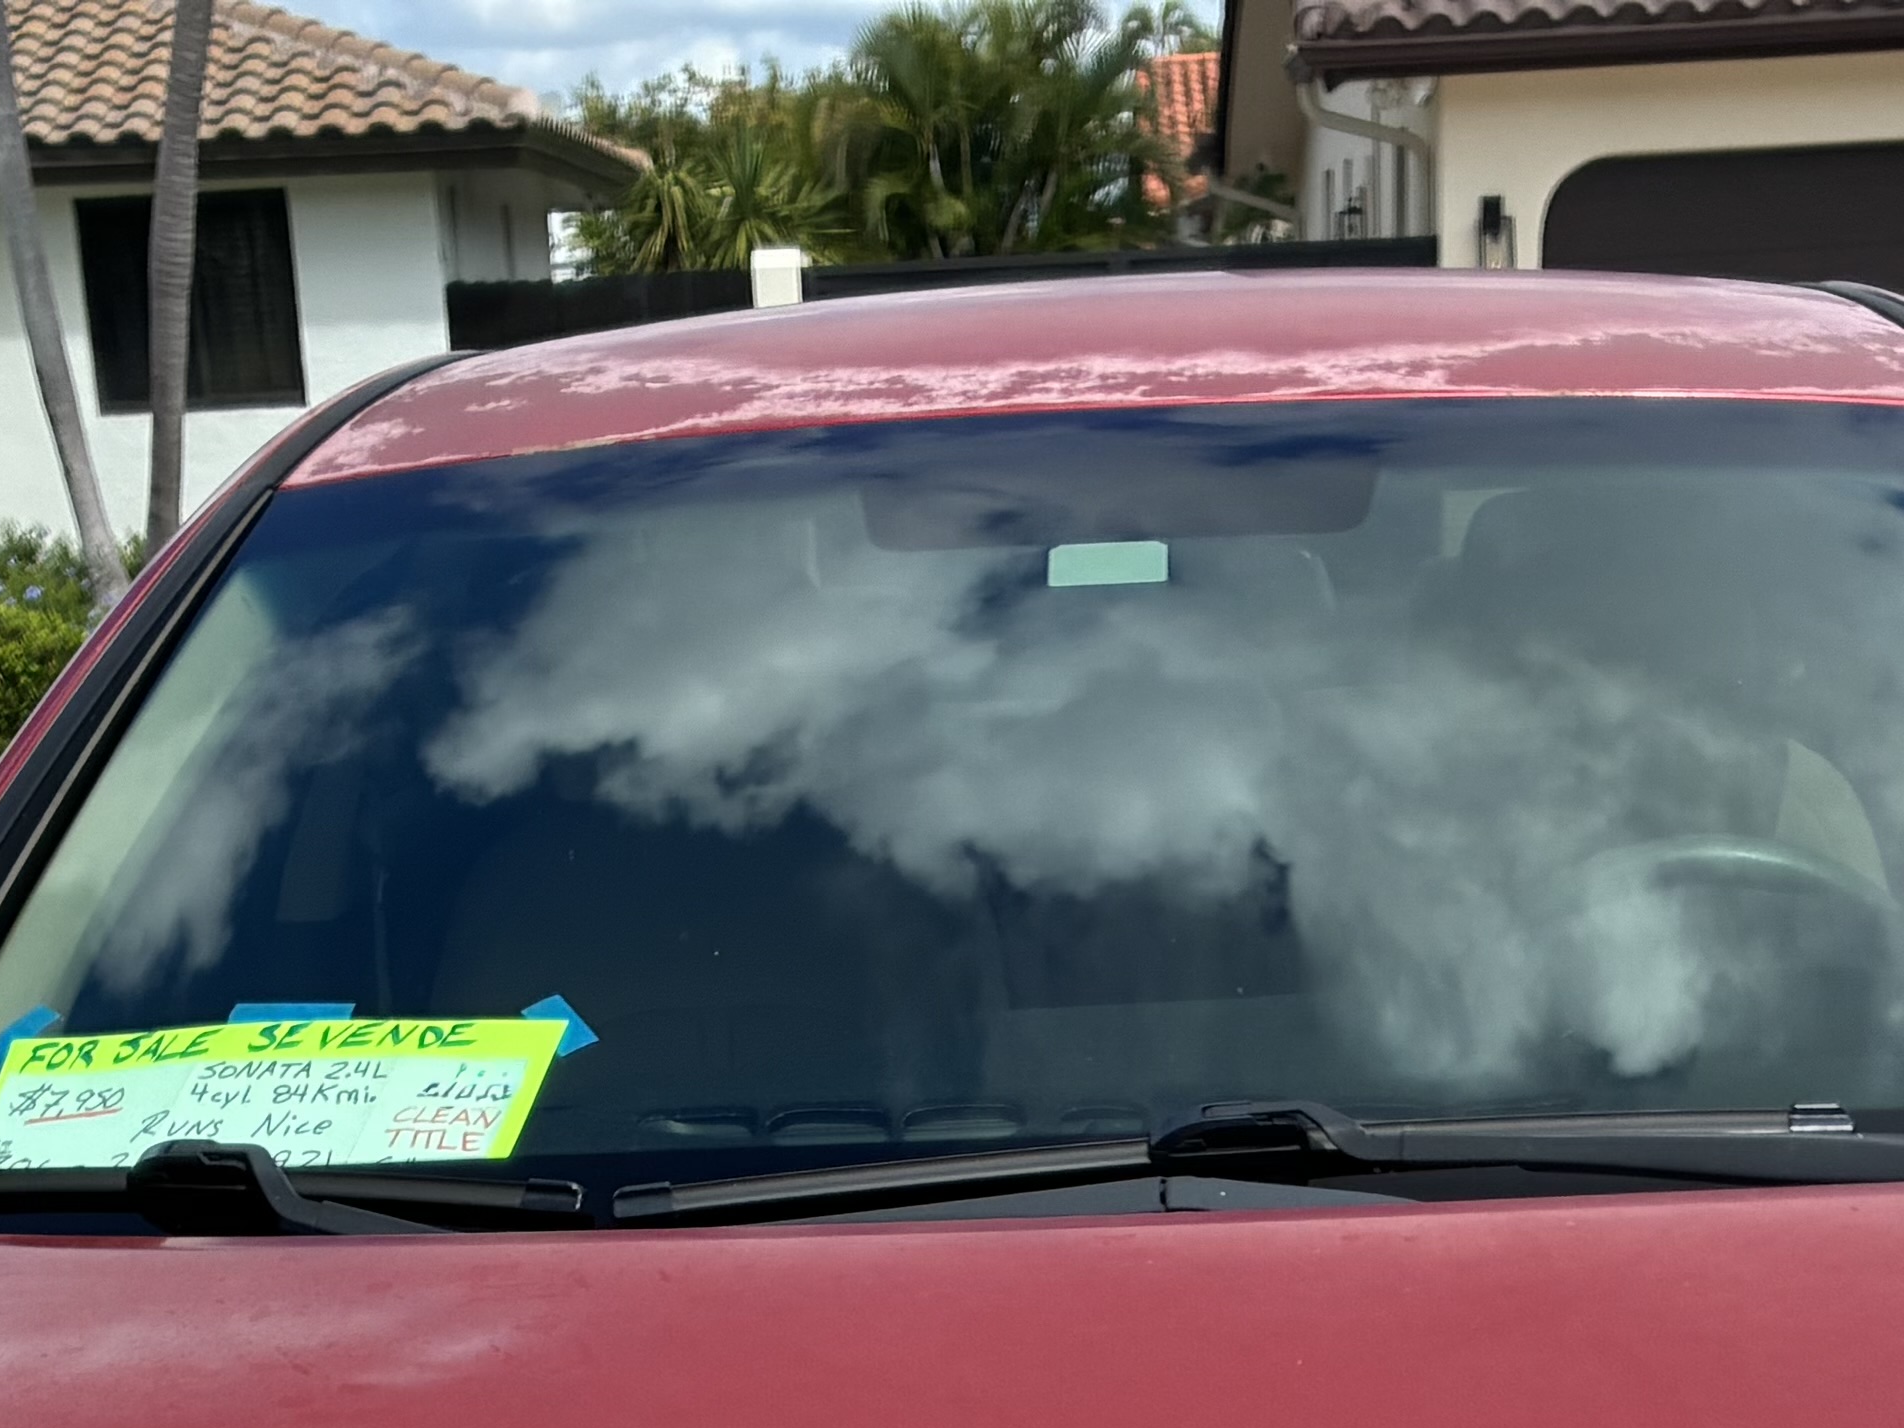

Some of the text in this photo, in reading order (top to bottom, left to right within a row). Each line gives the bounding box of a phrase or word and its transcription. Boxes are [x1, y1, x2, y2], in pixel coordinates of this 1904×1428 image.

[19, 1039, 100, 1074] FOR
[113, 1029, 225, 1063] SALE
[198, 1061, 388, 1080] SONATA 2.4L
[9, 1083, 126, 1119] $7,950
[130, 1110, 333, 1143] RUNS Nice
[393, 1106, 502, 1130] CLEAN
[385, 1128, 485, 1152] TITLE
